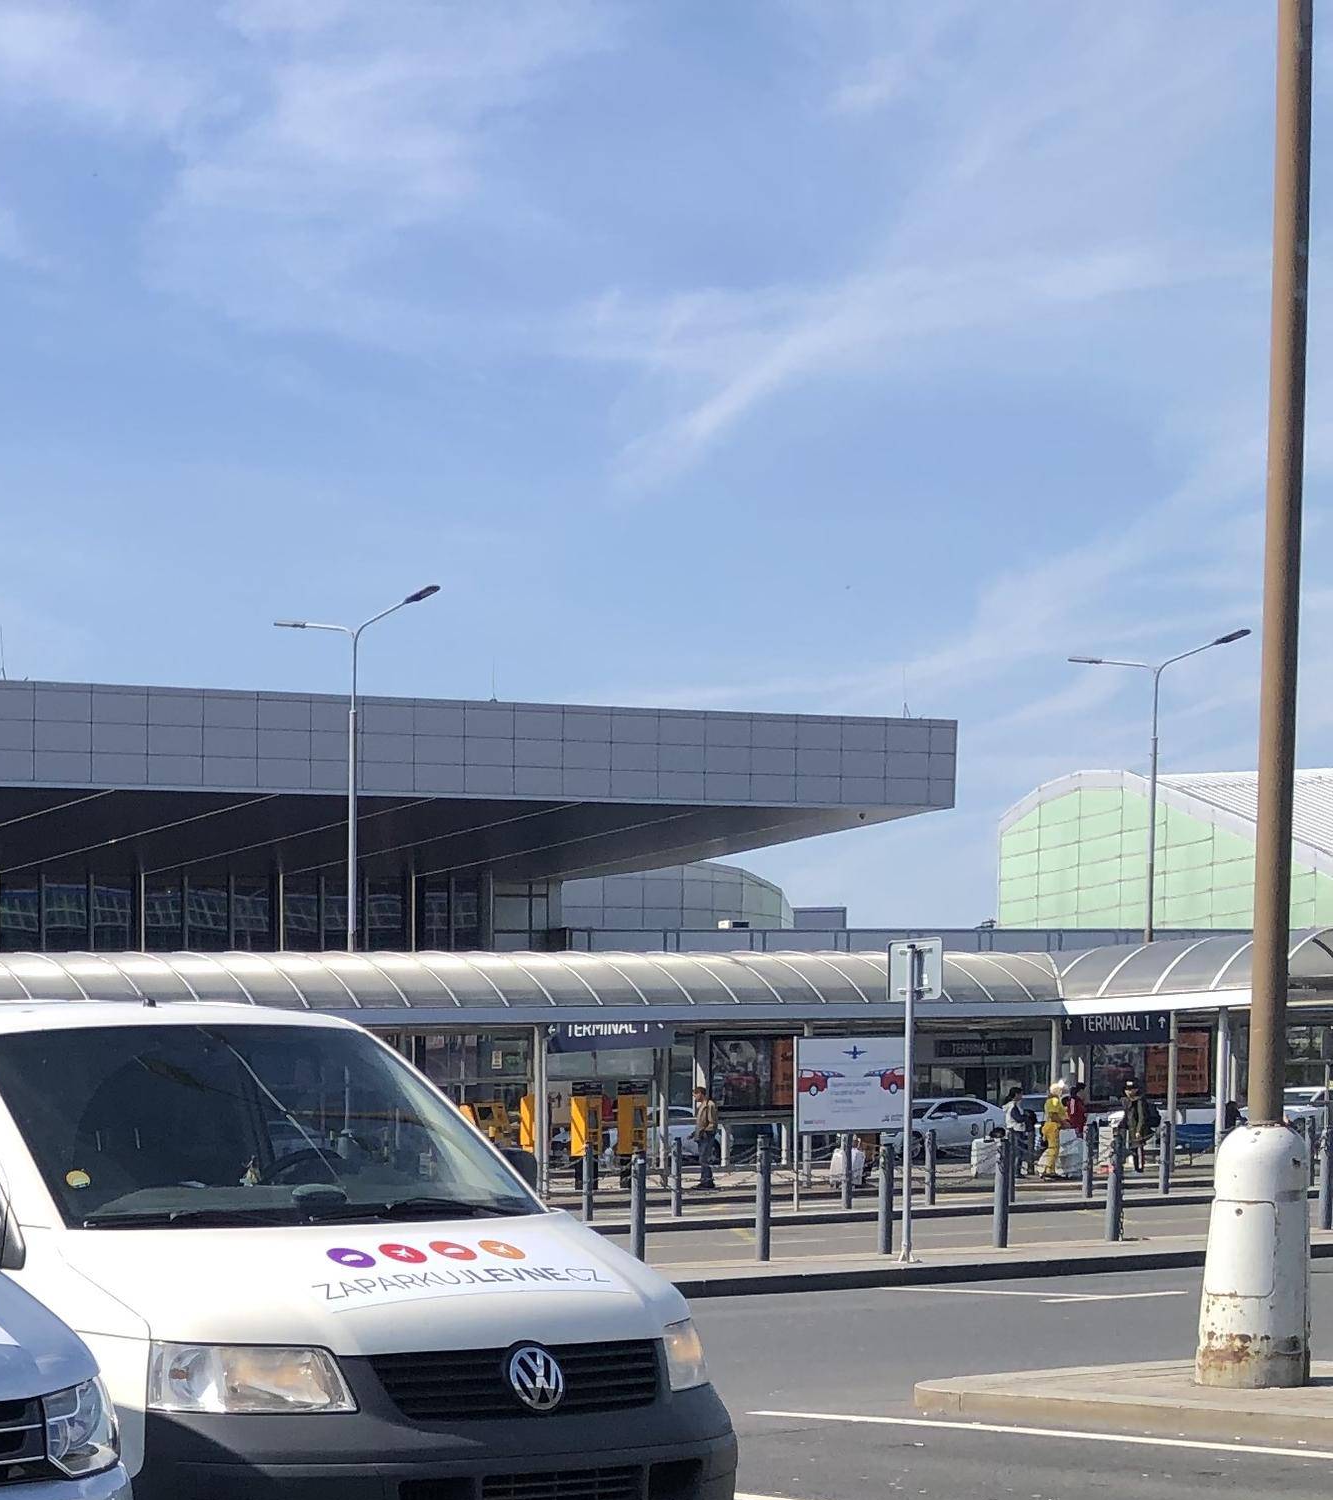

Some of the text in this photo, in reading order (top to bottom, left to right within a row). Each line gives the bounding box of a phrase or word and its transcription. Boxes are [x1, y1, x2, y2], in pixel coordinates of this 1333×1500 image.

[1083, 1014, 1150, 1032] TERMINAL 1
[310, 1266, 611, 1301] ZAPARKUJLEVNE.CZ
